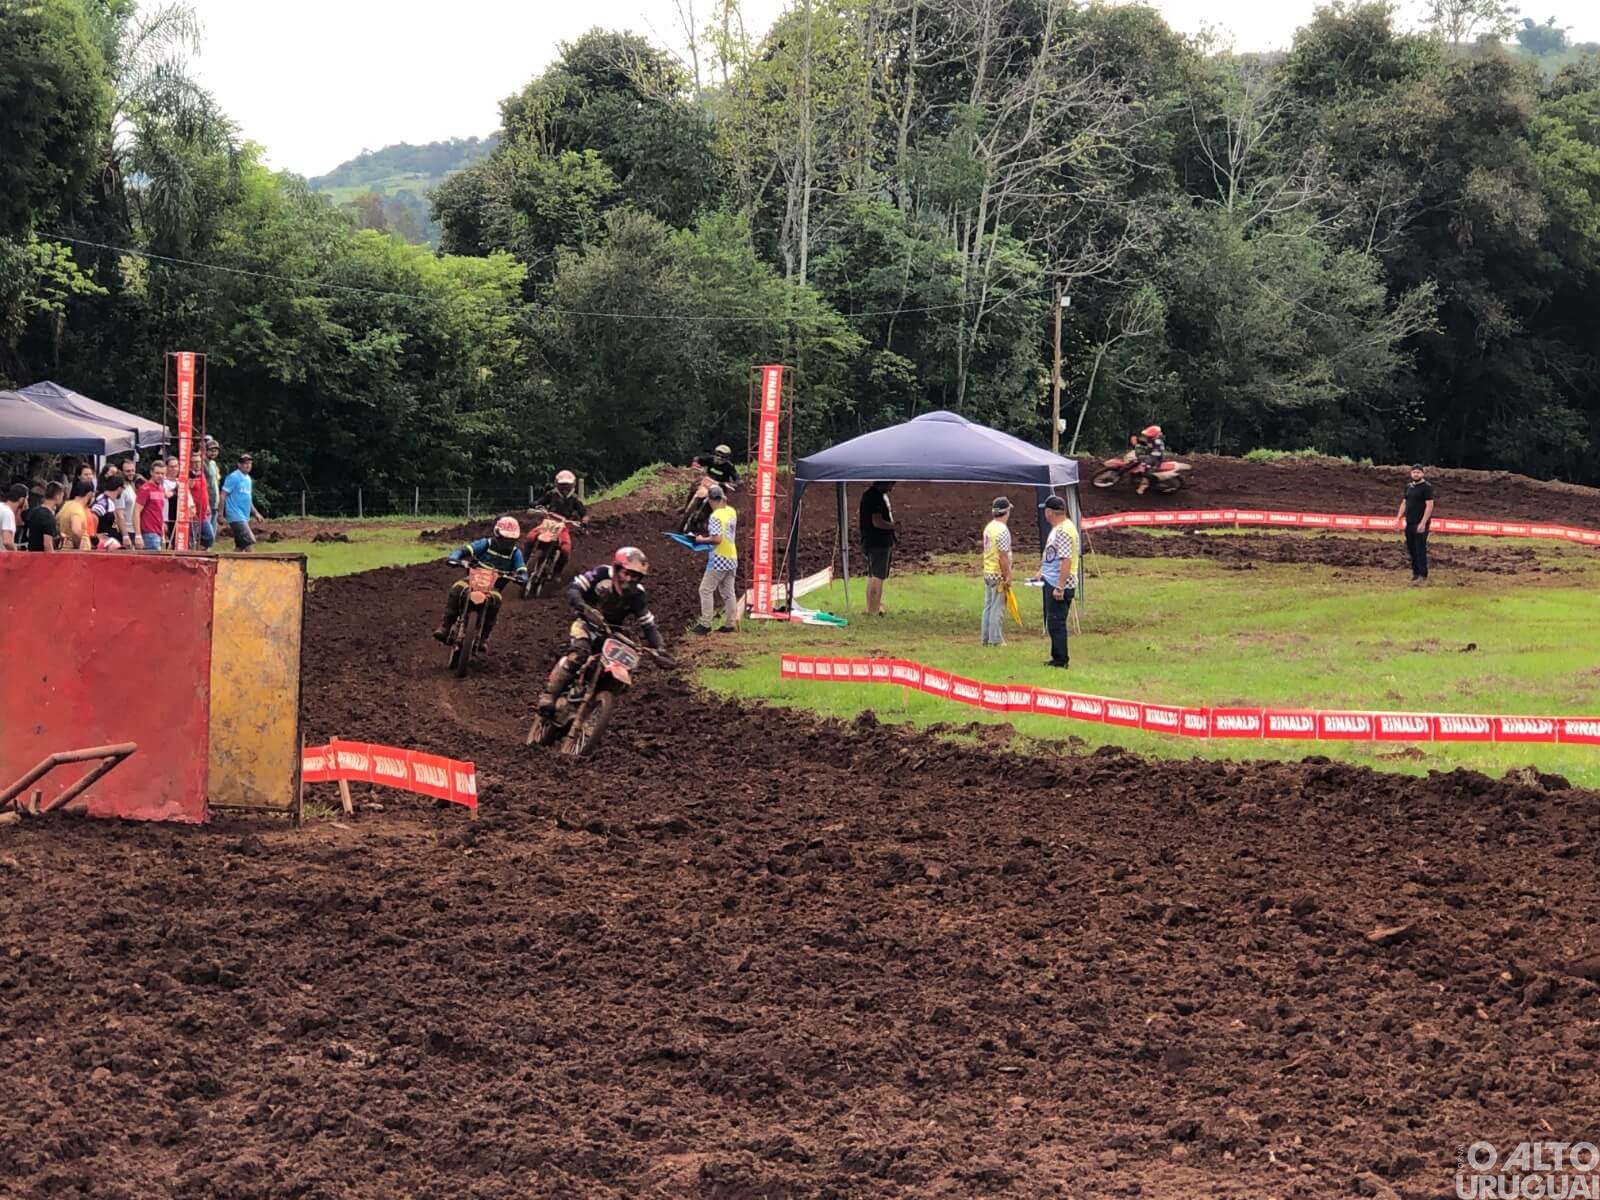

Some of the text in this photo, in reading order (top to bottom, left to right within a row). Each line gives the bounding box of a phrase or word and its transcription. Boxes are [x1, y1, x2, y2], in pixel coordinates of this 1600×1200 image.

[766, 370, 778, 411] RINALDI
[763, 421, 775, 462] RINALDI
[759, 521, 770, 564] RINALDI
[1216, 714, 1260, 731] RINALDI
[1269, 715, 1315, 731] RINALDI
[1324, 716, 1370, 732] RINALDI
[1381, 716, 1429, 733] RINALDI
[1439, 716, 1490, 734] RINALDI
[1501, 718, 1553, 735] RINALDI
